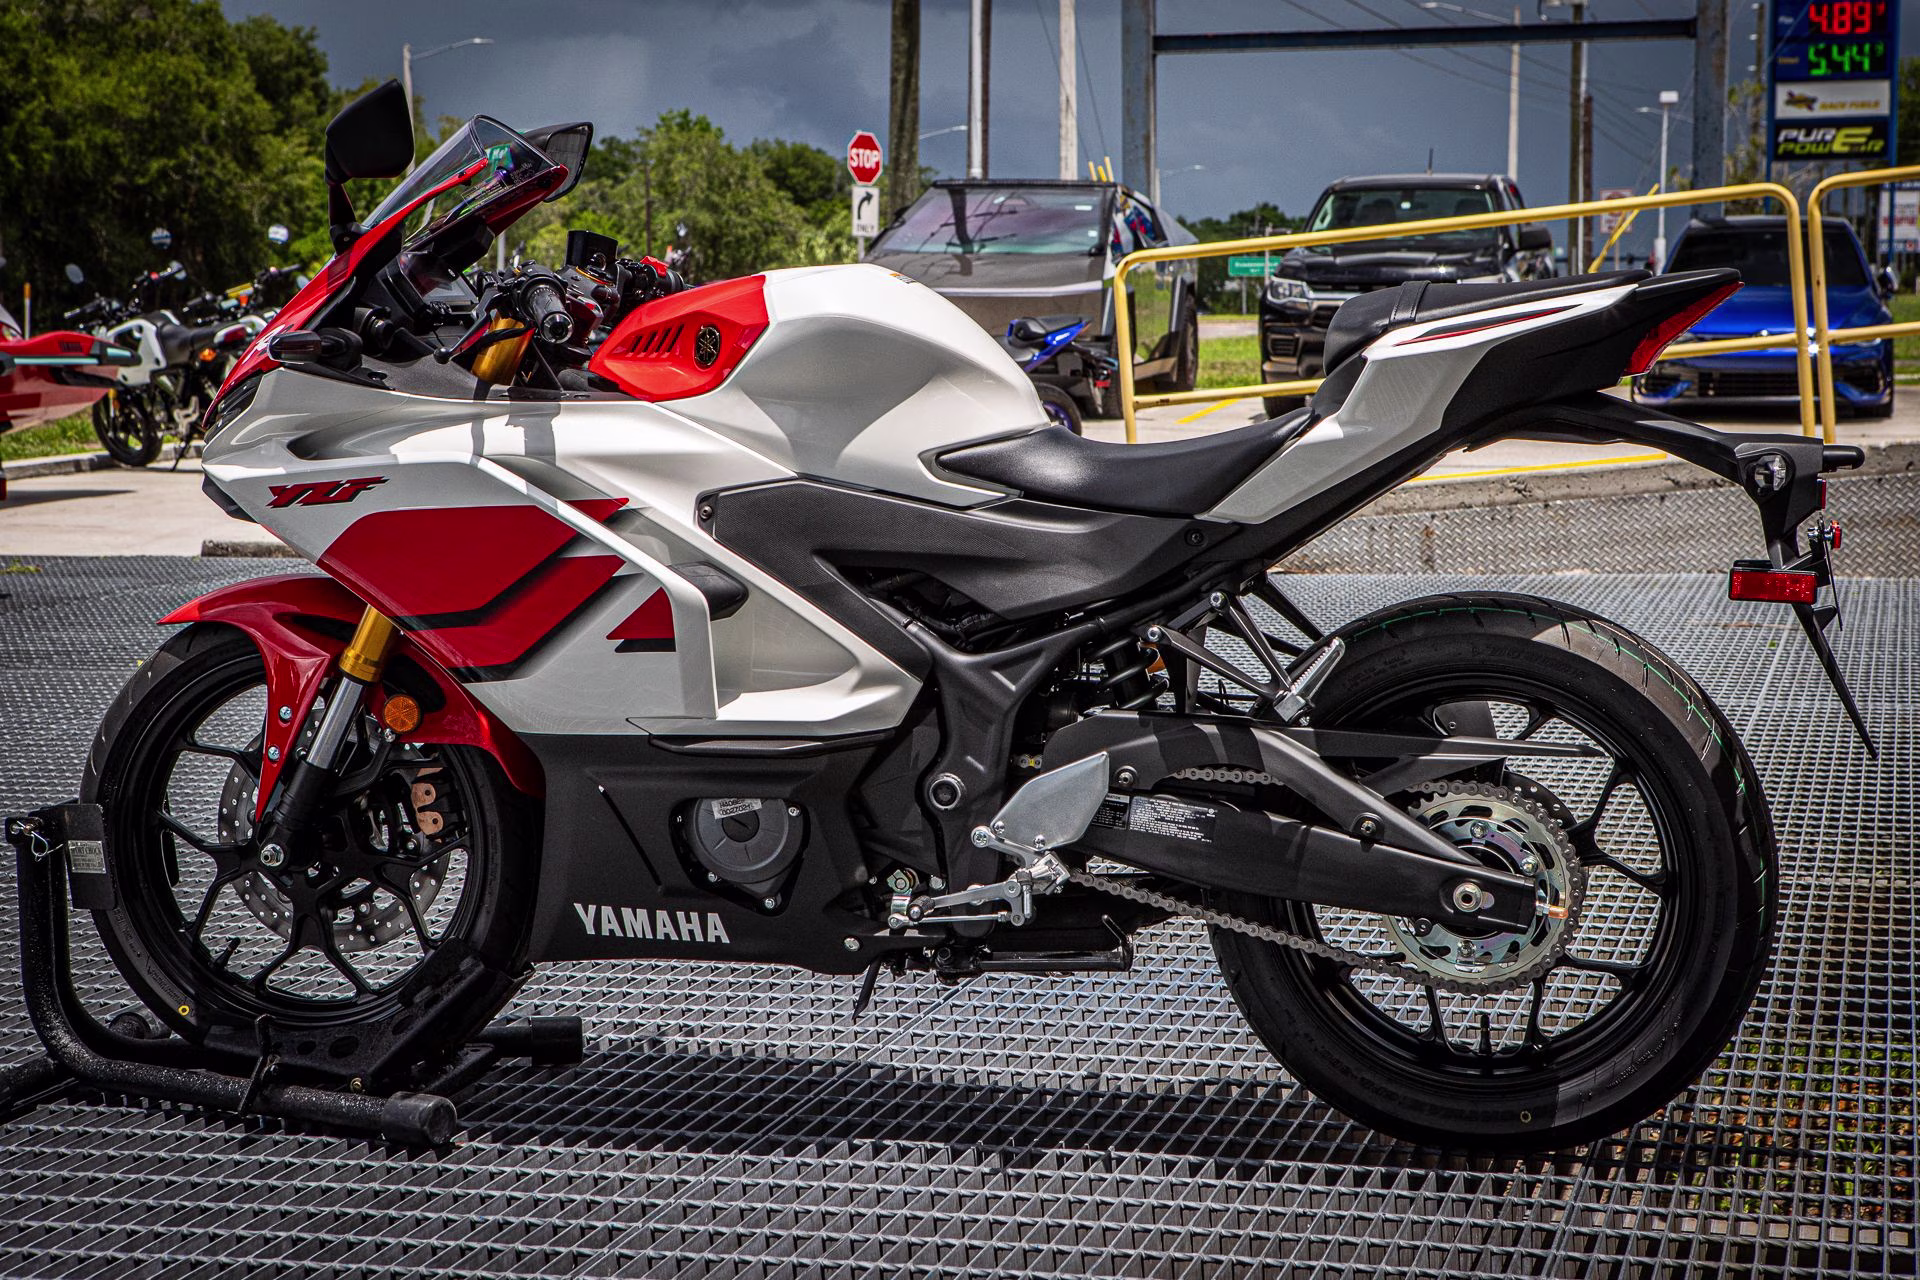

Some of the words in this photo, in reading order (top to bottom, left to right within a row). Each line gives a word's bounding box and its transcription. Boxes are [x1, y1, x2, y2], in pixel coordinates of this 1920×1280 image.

[1808, 42, 1870, 75] 5.44
[850, 148, 879, 169] STOP
[573, 902, 730, 944] YAMAHA
